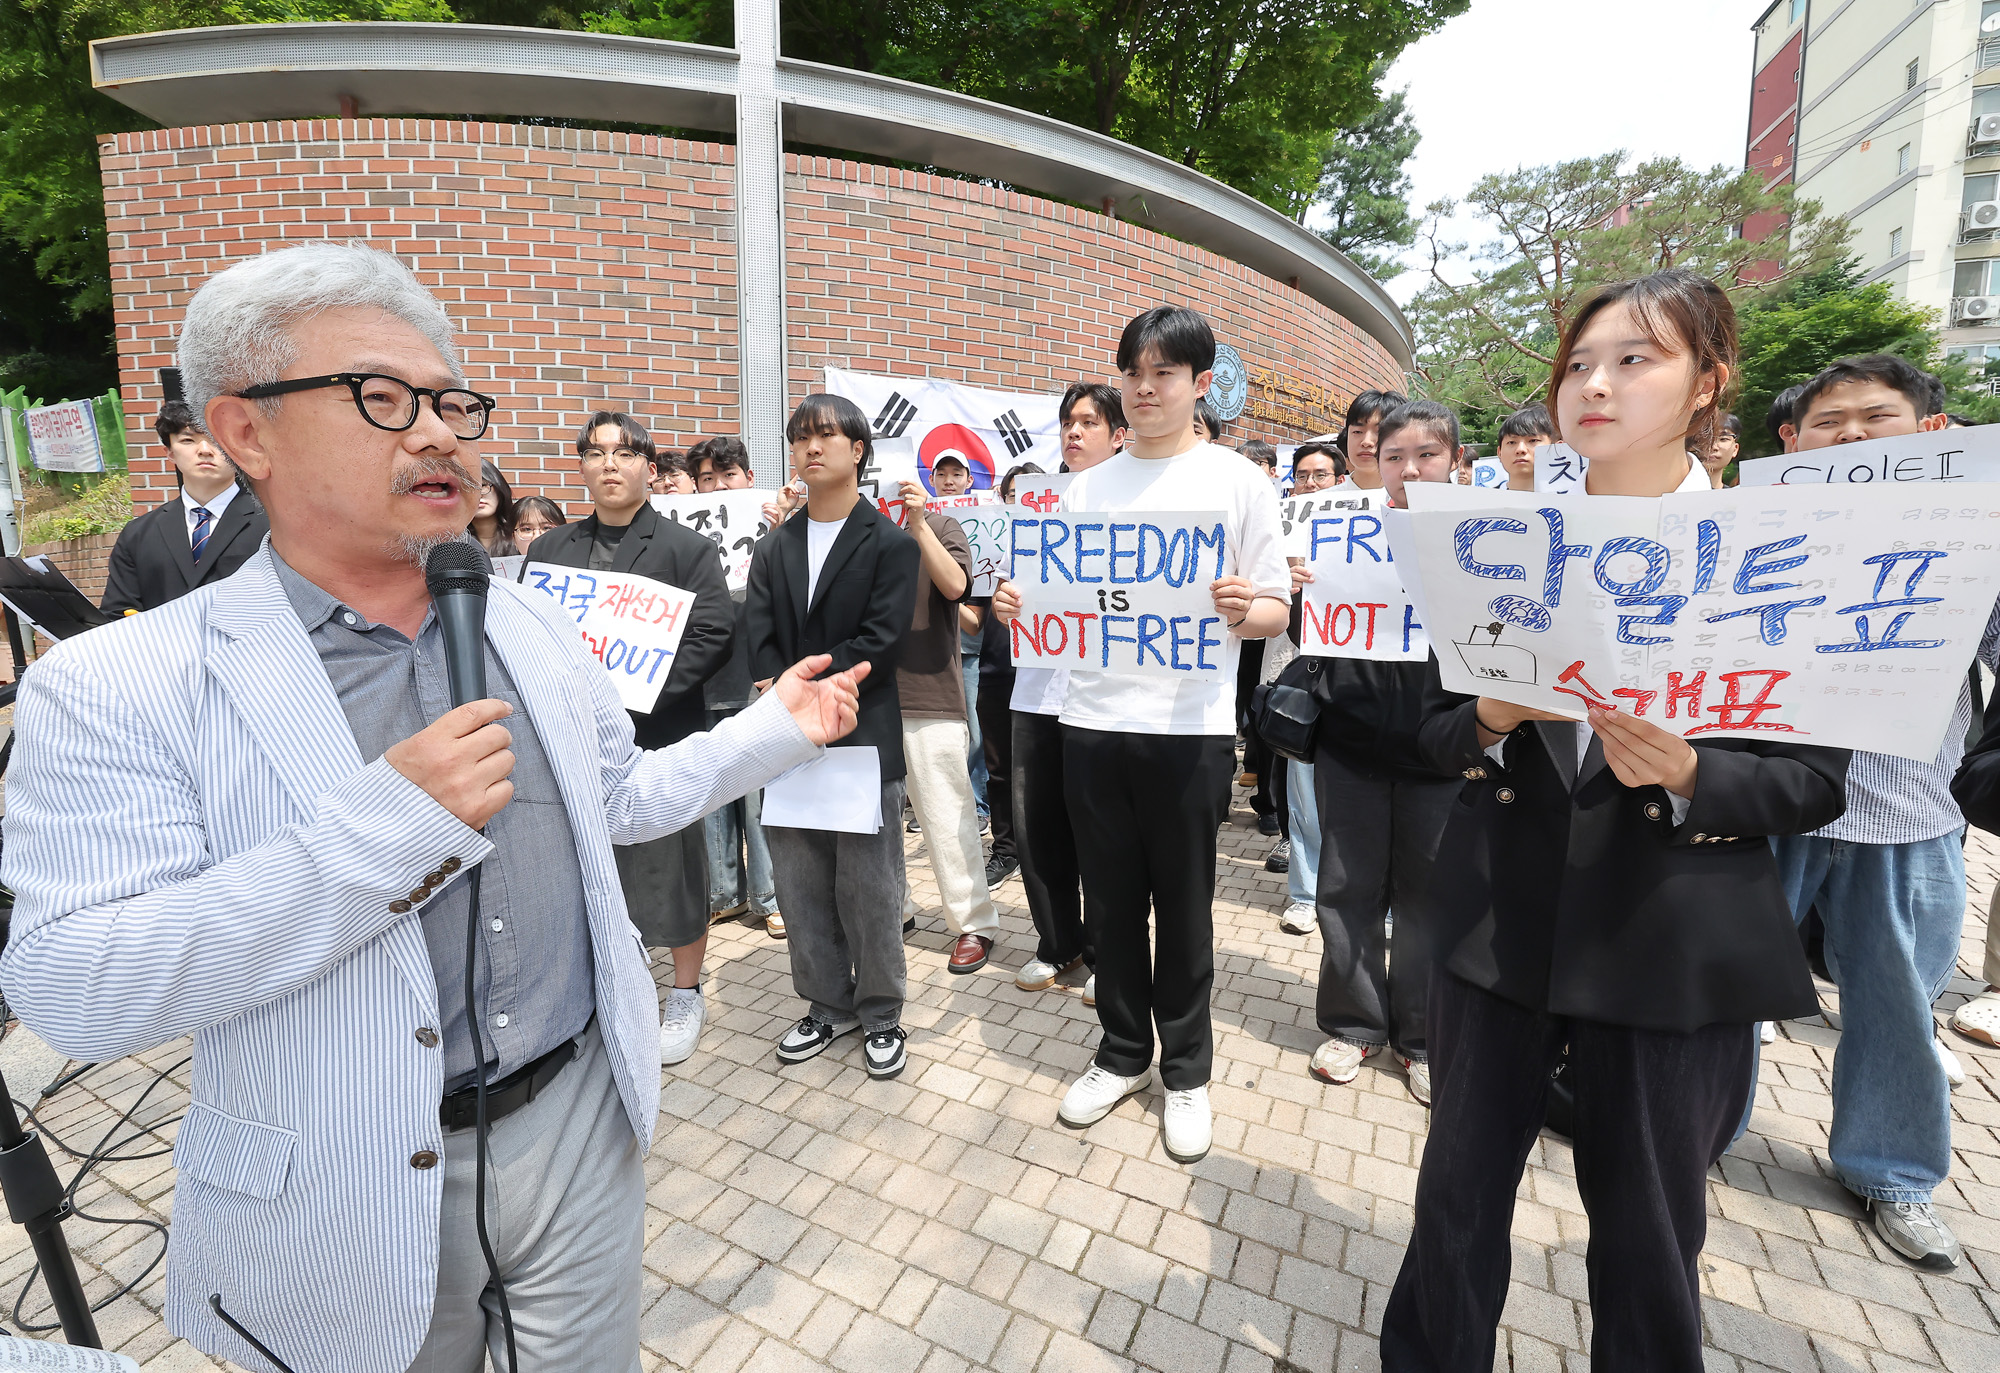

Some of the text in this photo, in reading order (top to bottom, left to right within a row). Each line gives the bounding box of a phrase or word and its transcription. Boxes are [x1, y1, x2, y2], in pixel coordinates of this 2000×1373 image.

[1252, 400, 1304, 425] Presbyterian
[1255, 367, 1351, 423] 장로회신
[1020, 488, 1060, 513] St
[1010, 519, 1226, 588] FREEDOM
[1310, 515, 1394, 563] FR
[598, 583, 684, 632] 재선거
[1097, 589, 1130, 612] is
[1011, 611, 1221, 670] NOT FREE
[1302, 600, 1388, 651] NOT
